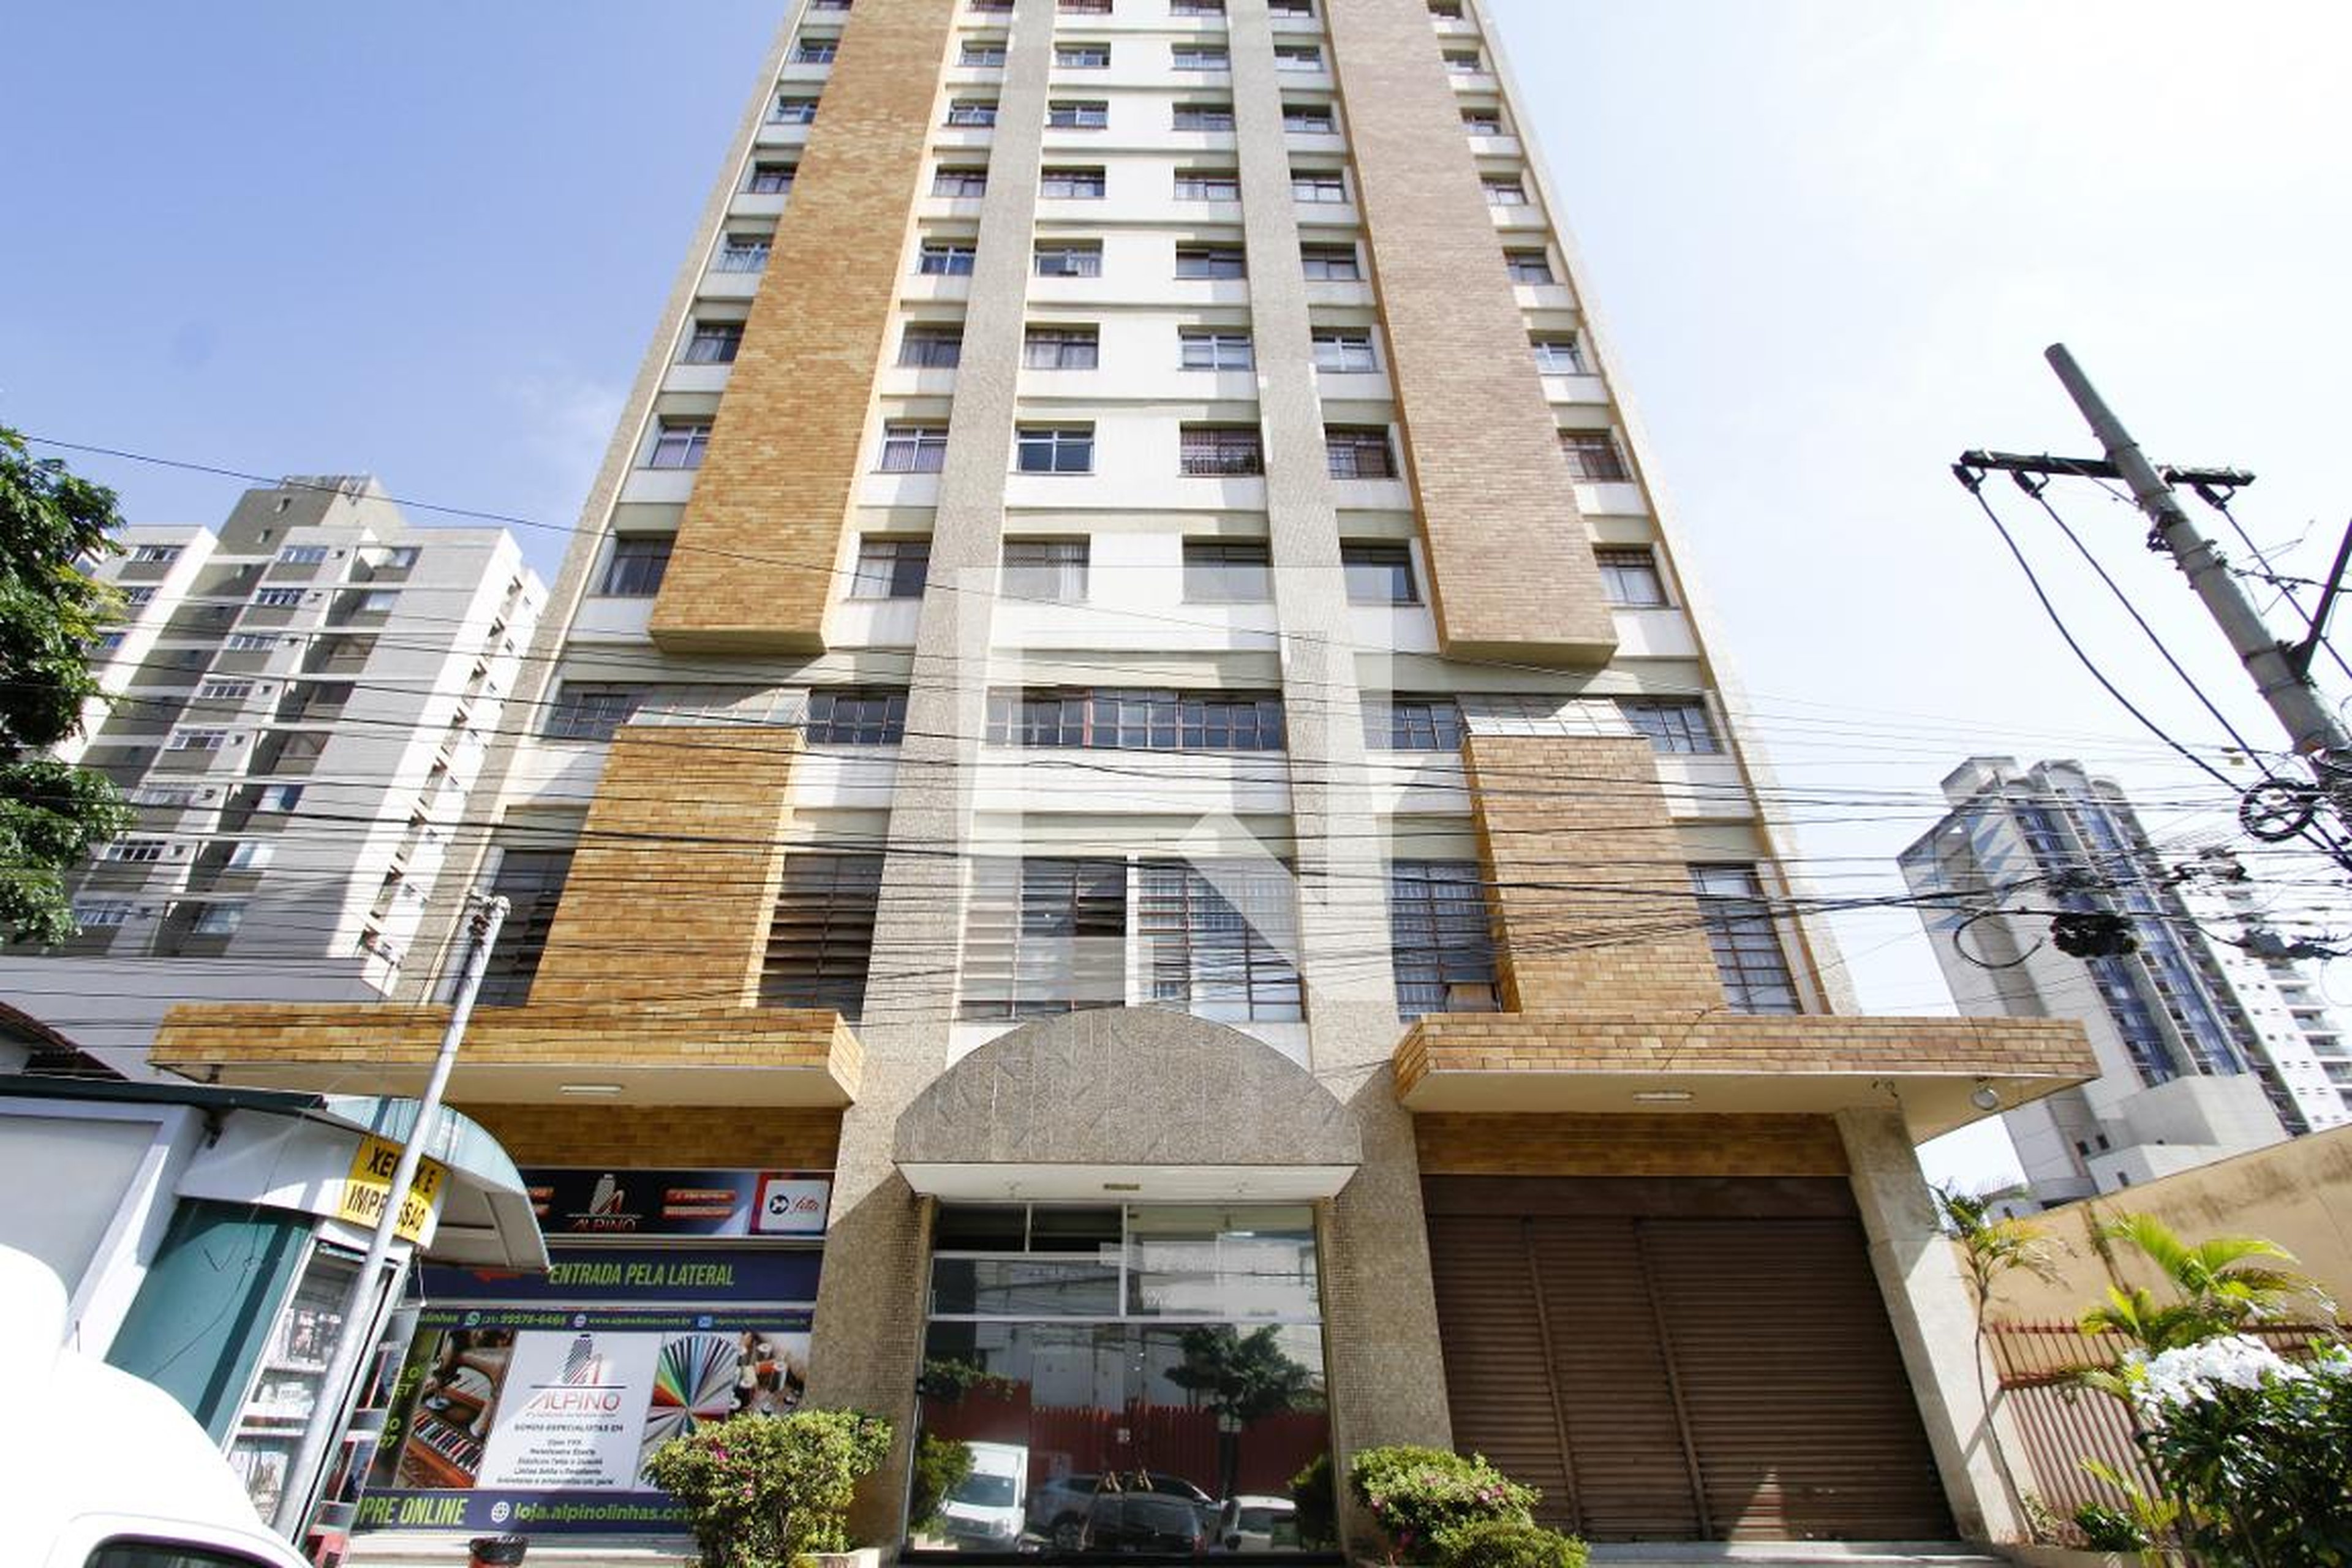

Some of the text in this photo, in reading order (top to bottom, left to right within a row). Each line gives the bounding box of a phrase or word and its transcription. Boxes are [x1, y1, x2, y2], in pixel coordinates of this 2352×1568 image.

[550, 1264, 734, 1286] ENTRADA PELA LATERAL
[529, 1392, 621, 1411] ALPINO
[401, 1496, 469, 1525] ONLINE
